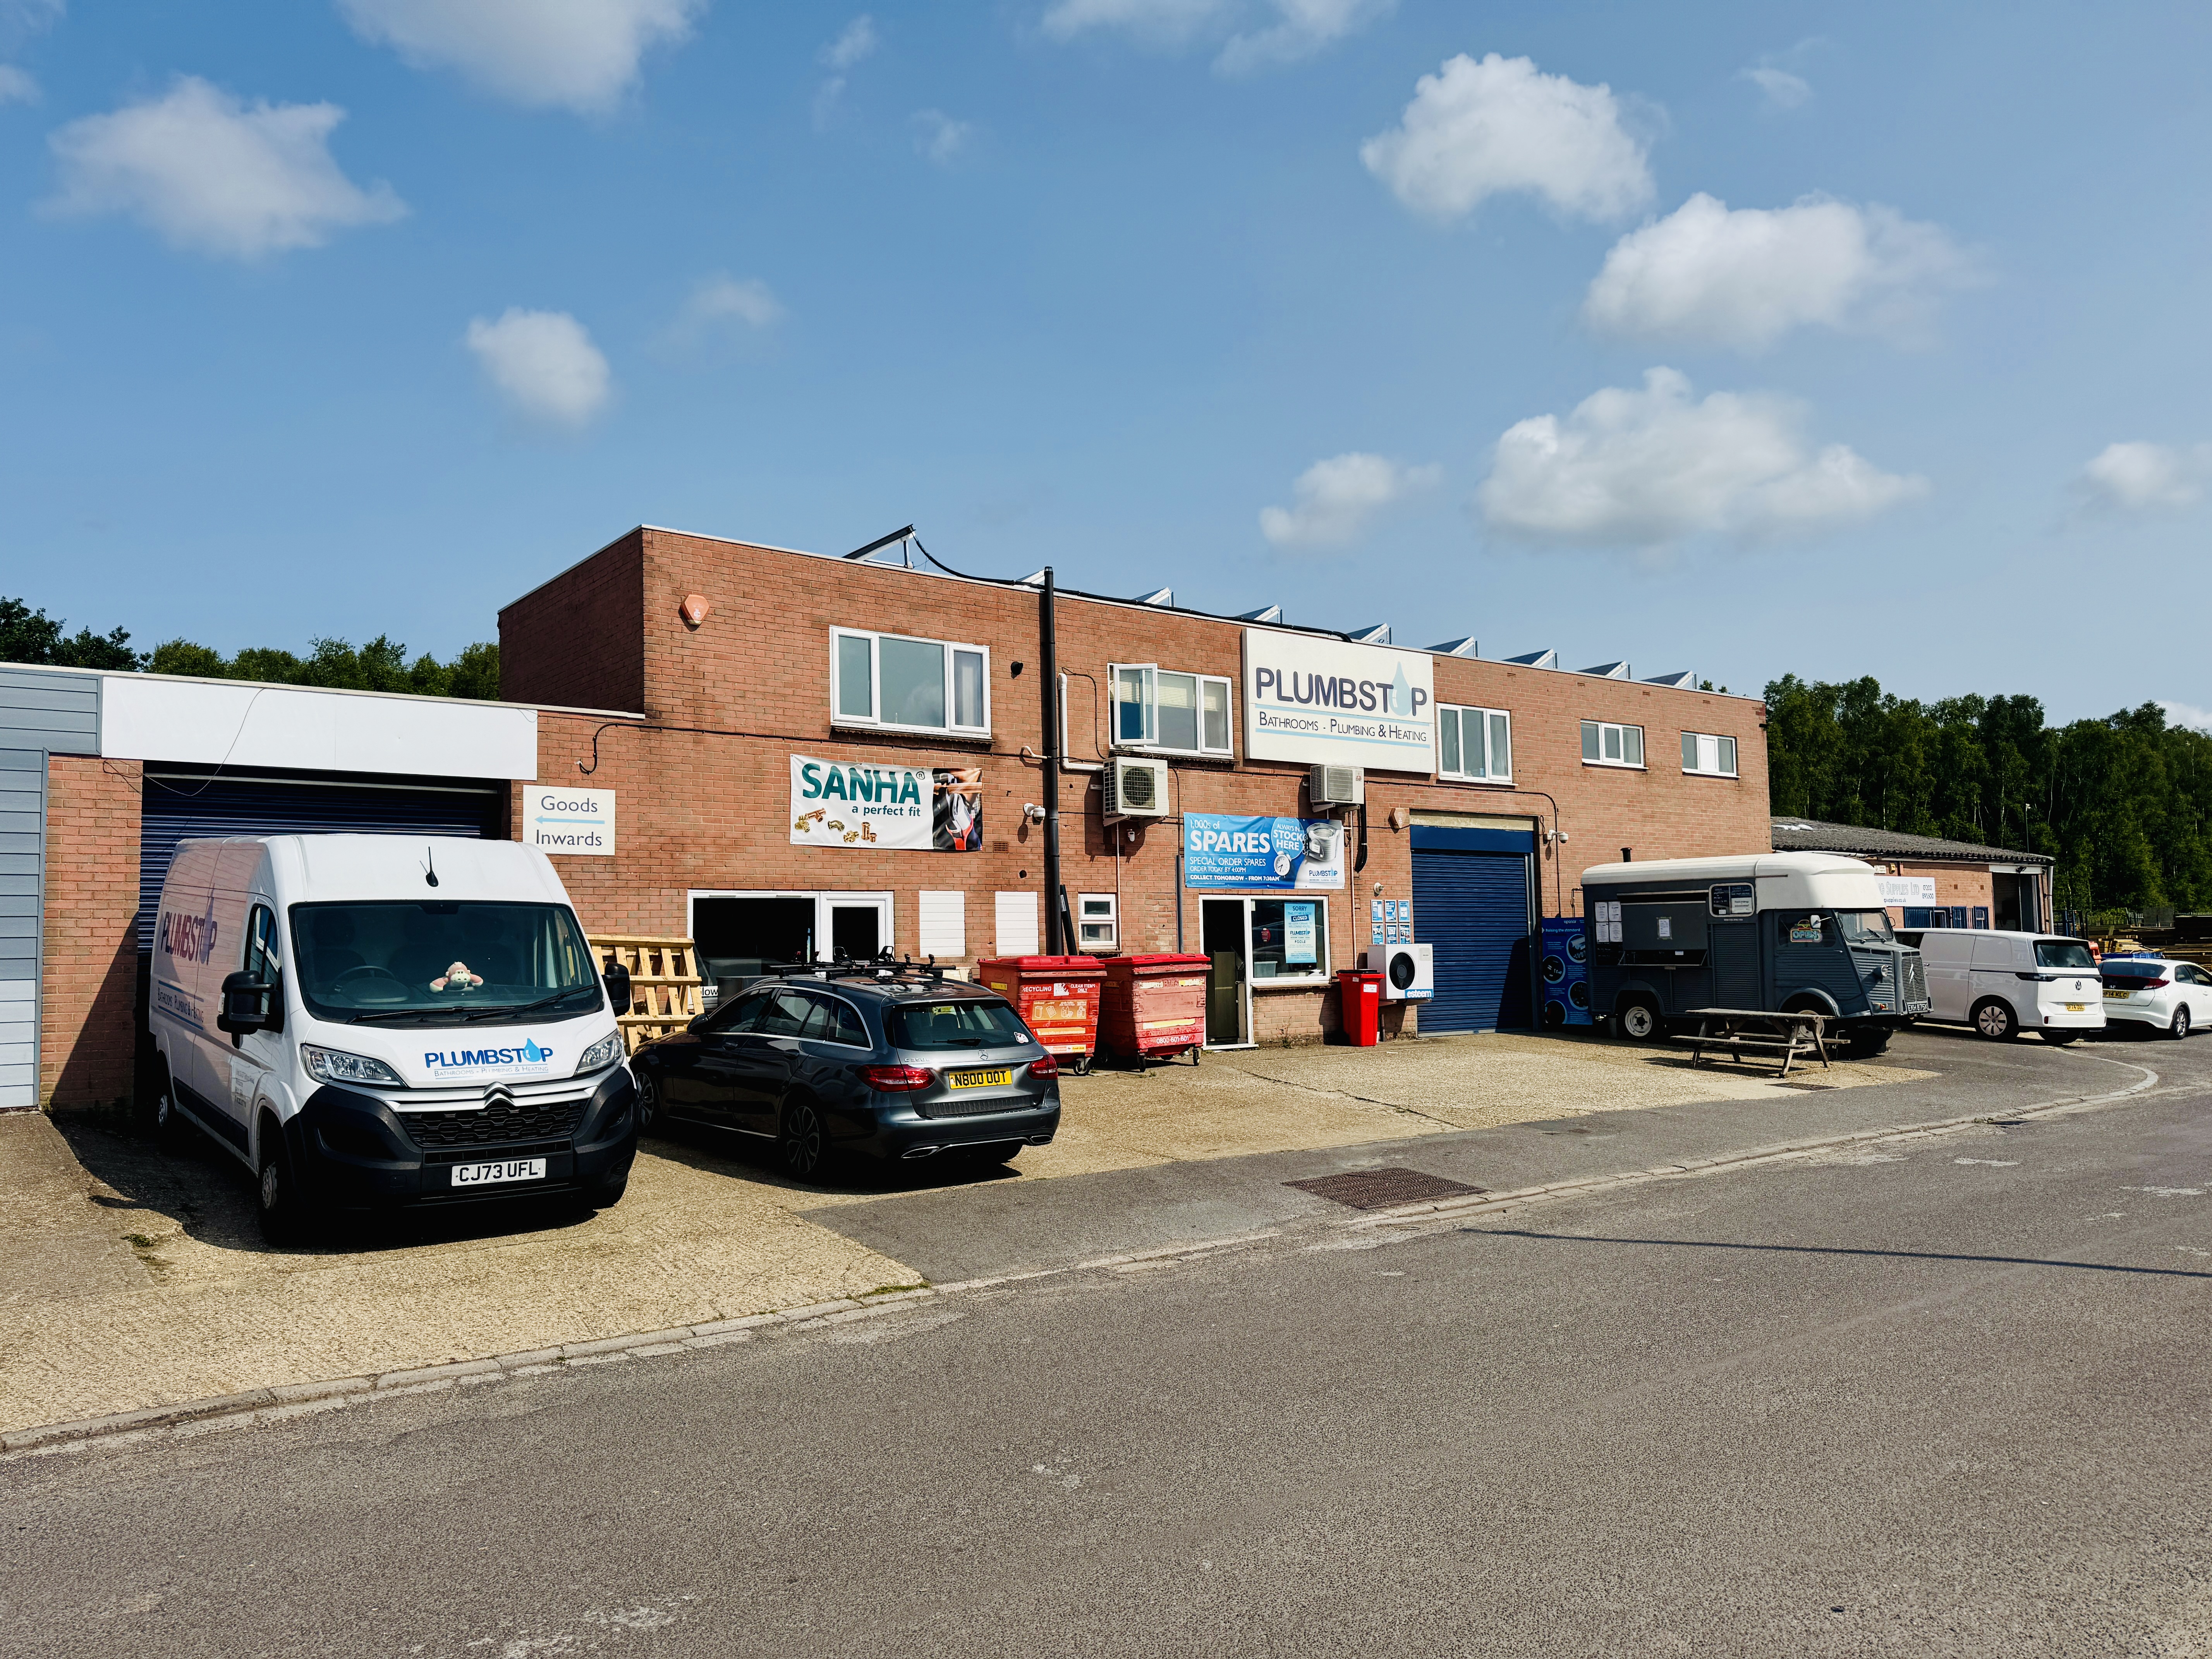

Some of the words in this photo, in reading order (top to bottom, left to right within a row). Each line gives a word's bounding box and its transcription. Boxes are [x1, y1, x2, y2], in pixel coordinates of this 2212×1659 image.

[1256, 661, 1427, 716] PLUMBSTOP
[1259, 711, 1319, 731] BATHROOMS
[1330, 718, 1375, 737] PLUMBING
[1378, 724, 1386, 738] &
[1389, 725, 1427, 742] HEATING
[802, 763, 921, 805] SANHA
[541, 795, 598, 812] Goods
[863, 805, 904, 817] perfect
[908, 806, 921, 817] fit
[1190, 819, 1211, 830] 1,000s
[1213, 821, 1220, 829] of
[536, 829, 602, 846] Inwards
[1190, 830, 1271, 854] SPARES
[1273, 829, 1303, 842] STOCK
[1276, 839, 1300, 851] HERE
[1189, 857, 1217, 866] SPECIAL
[1218, 857, 1243, 866] ORDER
[1244, 858, 1266, 866] SPARES
[1309, 867, 1338, 877] PLUMBSTOP
[160, 896, 218, 966] PLUMBSTOP
[701, 987, 718, 996] low
[1407, 989, 1432, 998] esteem
[424, 1038, 553, 1068] PLUMBSTOP
[954, 1072, 984, 1087] N800
[459, 1164, 503, 1182] CJ73
[507, 1161, 538, 1178] UFL
